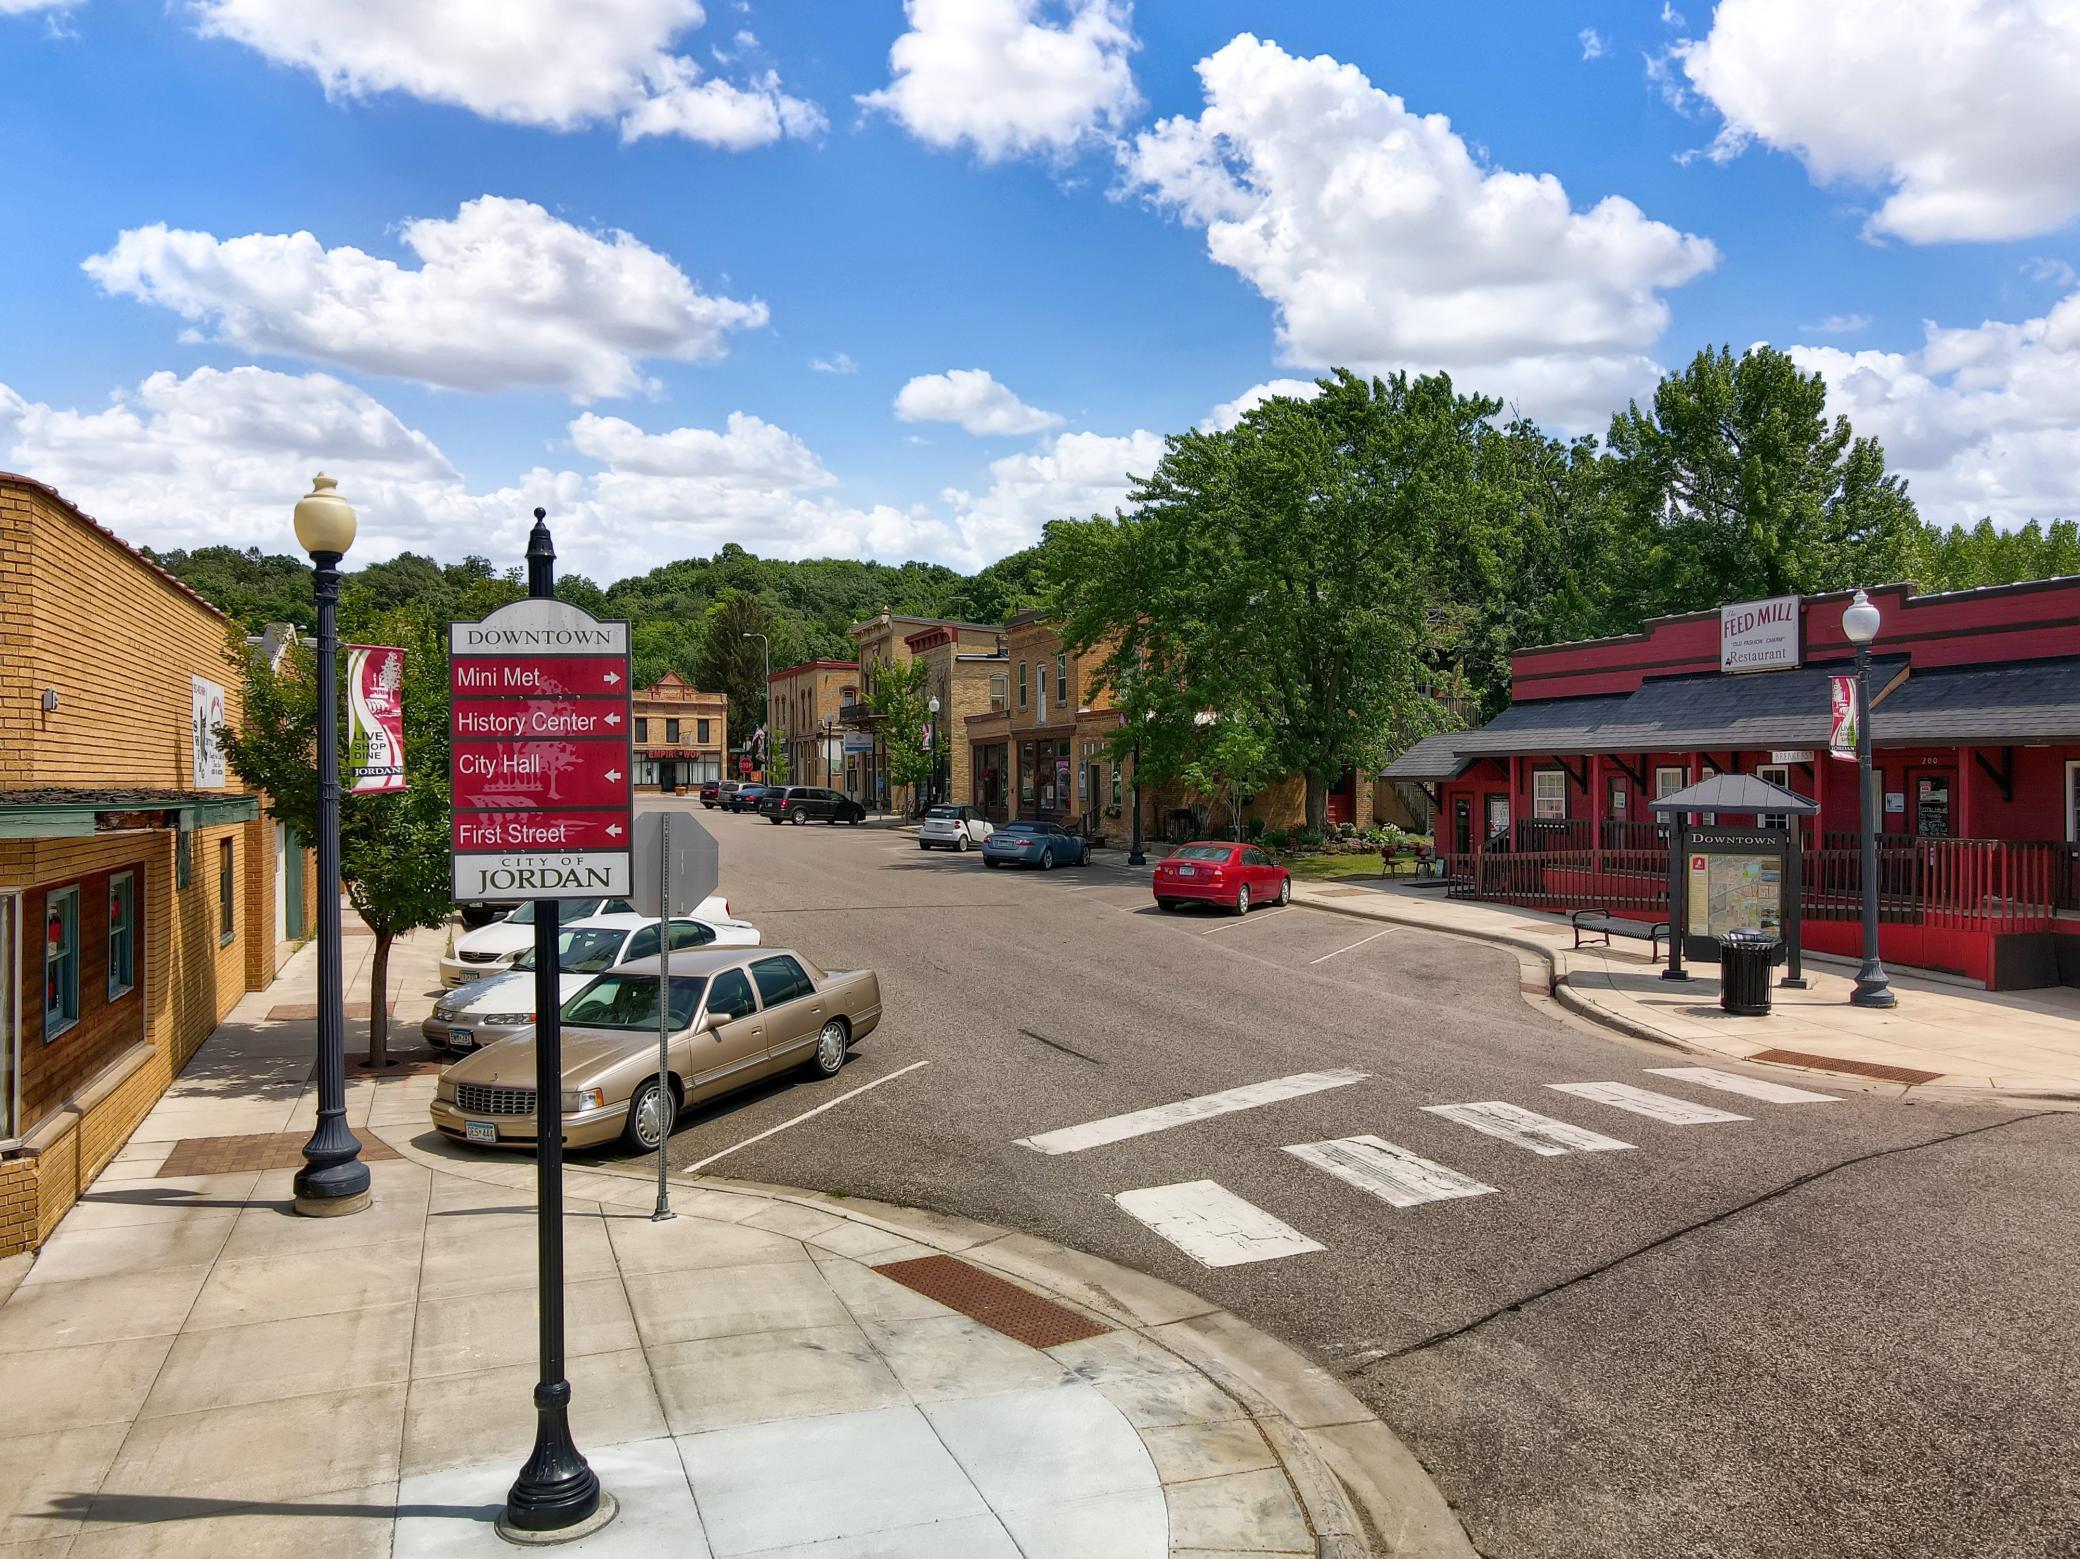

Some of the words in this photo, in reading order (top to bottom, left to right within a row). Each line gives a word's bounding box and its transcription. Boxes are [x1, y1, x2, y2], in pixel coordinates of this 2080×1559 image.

[1724, 612, 1755, 638] FEED
[1757, 603, 1793, 627] MILL
[467, 630, 612, 645] DOWNTOWN
[1730, 648, 1786, 663] Restaurant
[457, 667, 497, 687] Mini
[504, 667, 540, 687] Met
[458, 713, 526, 737] History
[532, 711, 597, 732] Center
[354, 731, 384, 741] LIVE
[354, 742, 387, 751] SHOP
[354, 751, 382, 760] DINE
[1774, 751, 1813, 761] BREAKFAST
[1921, 757, 1938, 765] 200
[355, 765, 402, 777] JORDAN
[459, 754, 497, 779] City
[503, 753, 540, 774] Hall
[459, 824, 502, 844] First
[508, 823, 566, 844] Street
[501, 857, 548, 867] CITY
[561, 857, 585, 866] OF
[479, 867, 612, 895] JORDAN
